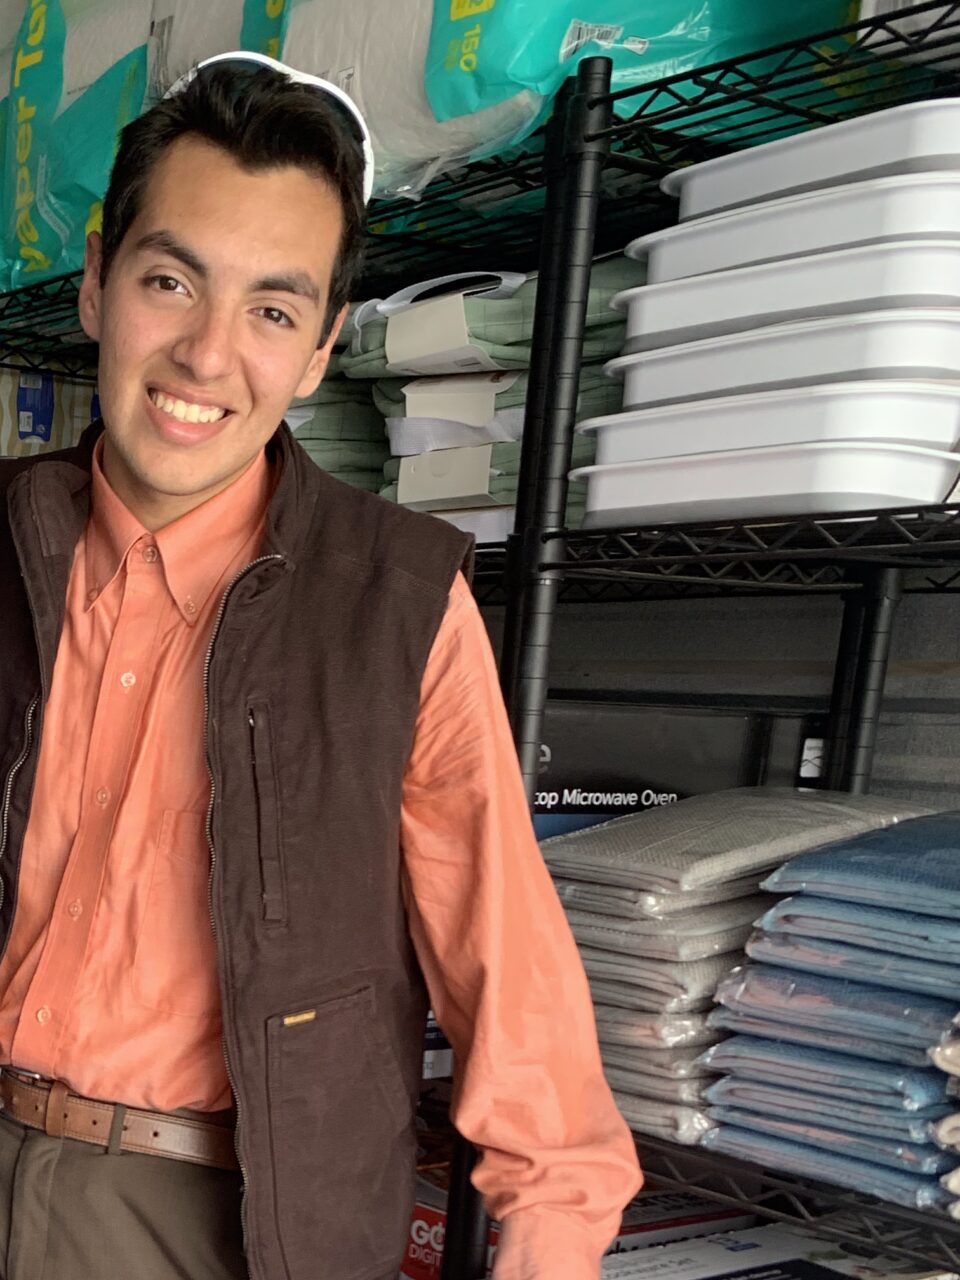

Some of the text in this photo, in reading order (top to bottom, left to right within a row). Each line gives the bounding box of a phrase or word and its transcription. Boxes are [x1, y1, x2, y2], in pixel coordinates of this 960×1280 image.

[460, 24, 481, 72] 150
[561, 788, 638, 805] Microwave
[641, 789, 677, 806] Oven
[408, 1244, 443, 1267] DIGIT
